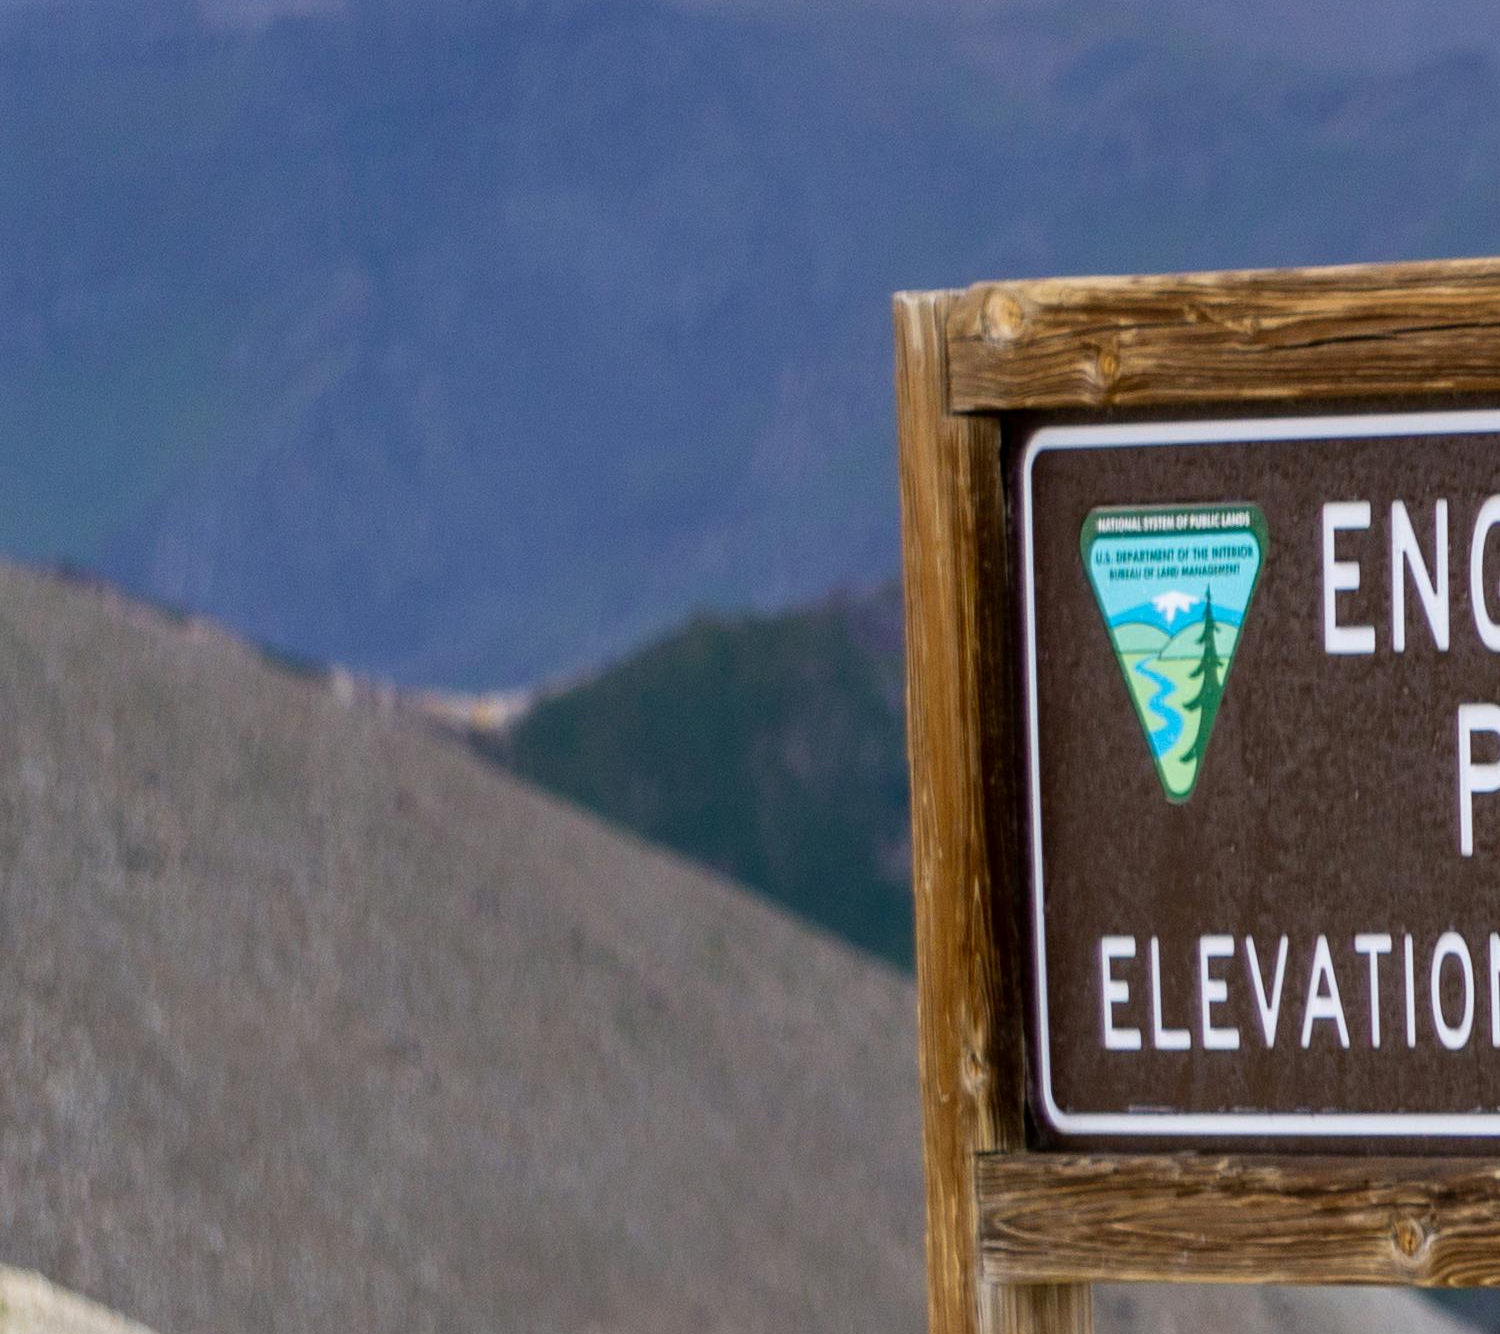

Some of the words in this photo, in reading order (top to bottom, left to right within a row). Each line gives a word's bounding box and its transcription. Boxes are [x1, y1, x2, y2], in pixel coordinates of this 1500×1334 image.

[1098, 517, 1141, 533] NATIONAL
[1143, 515, 1174, 531] SYSTEM
[1176, 515, 1188, 530] OF
[1190, 513, 1219, 529] PUBLIC
[1221, 512, 1250, 528] LANDS
[1096, 551, 1112, 564] U.S.
[1116, 549, 1175, 563] DEPARTMENT
[1177, 548, 1189, 560] OF
[1193, 547, 1209, 560] THE
[1212, 546, 1253, 559] INTERIOR
[1110, 568, 1141, 580] BUREAU
[1144, 567, 1154, 579] OF
[1157, 566, 1179, 578] LAND
[1182, 563, 1240, 577] MANAGEMENT
